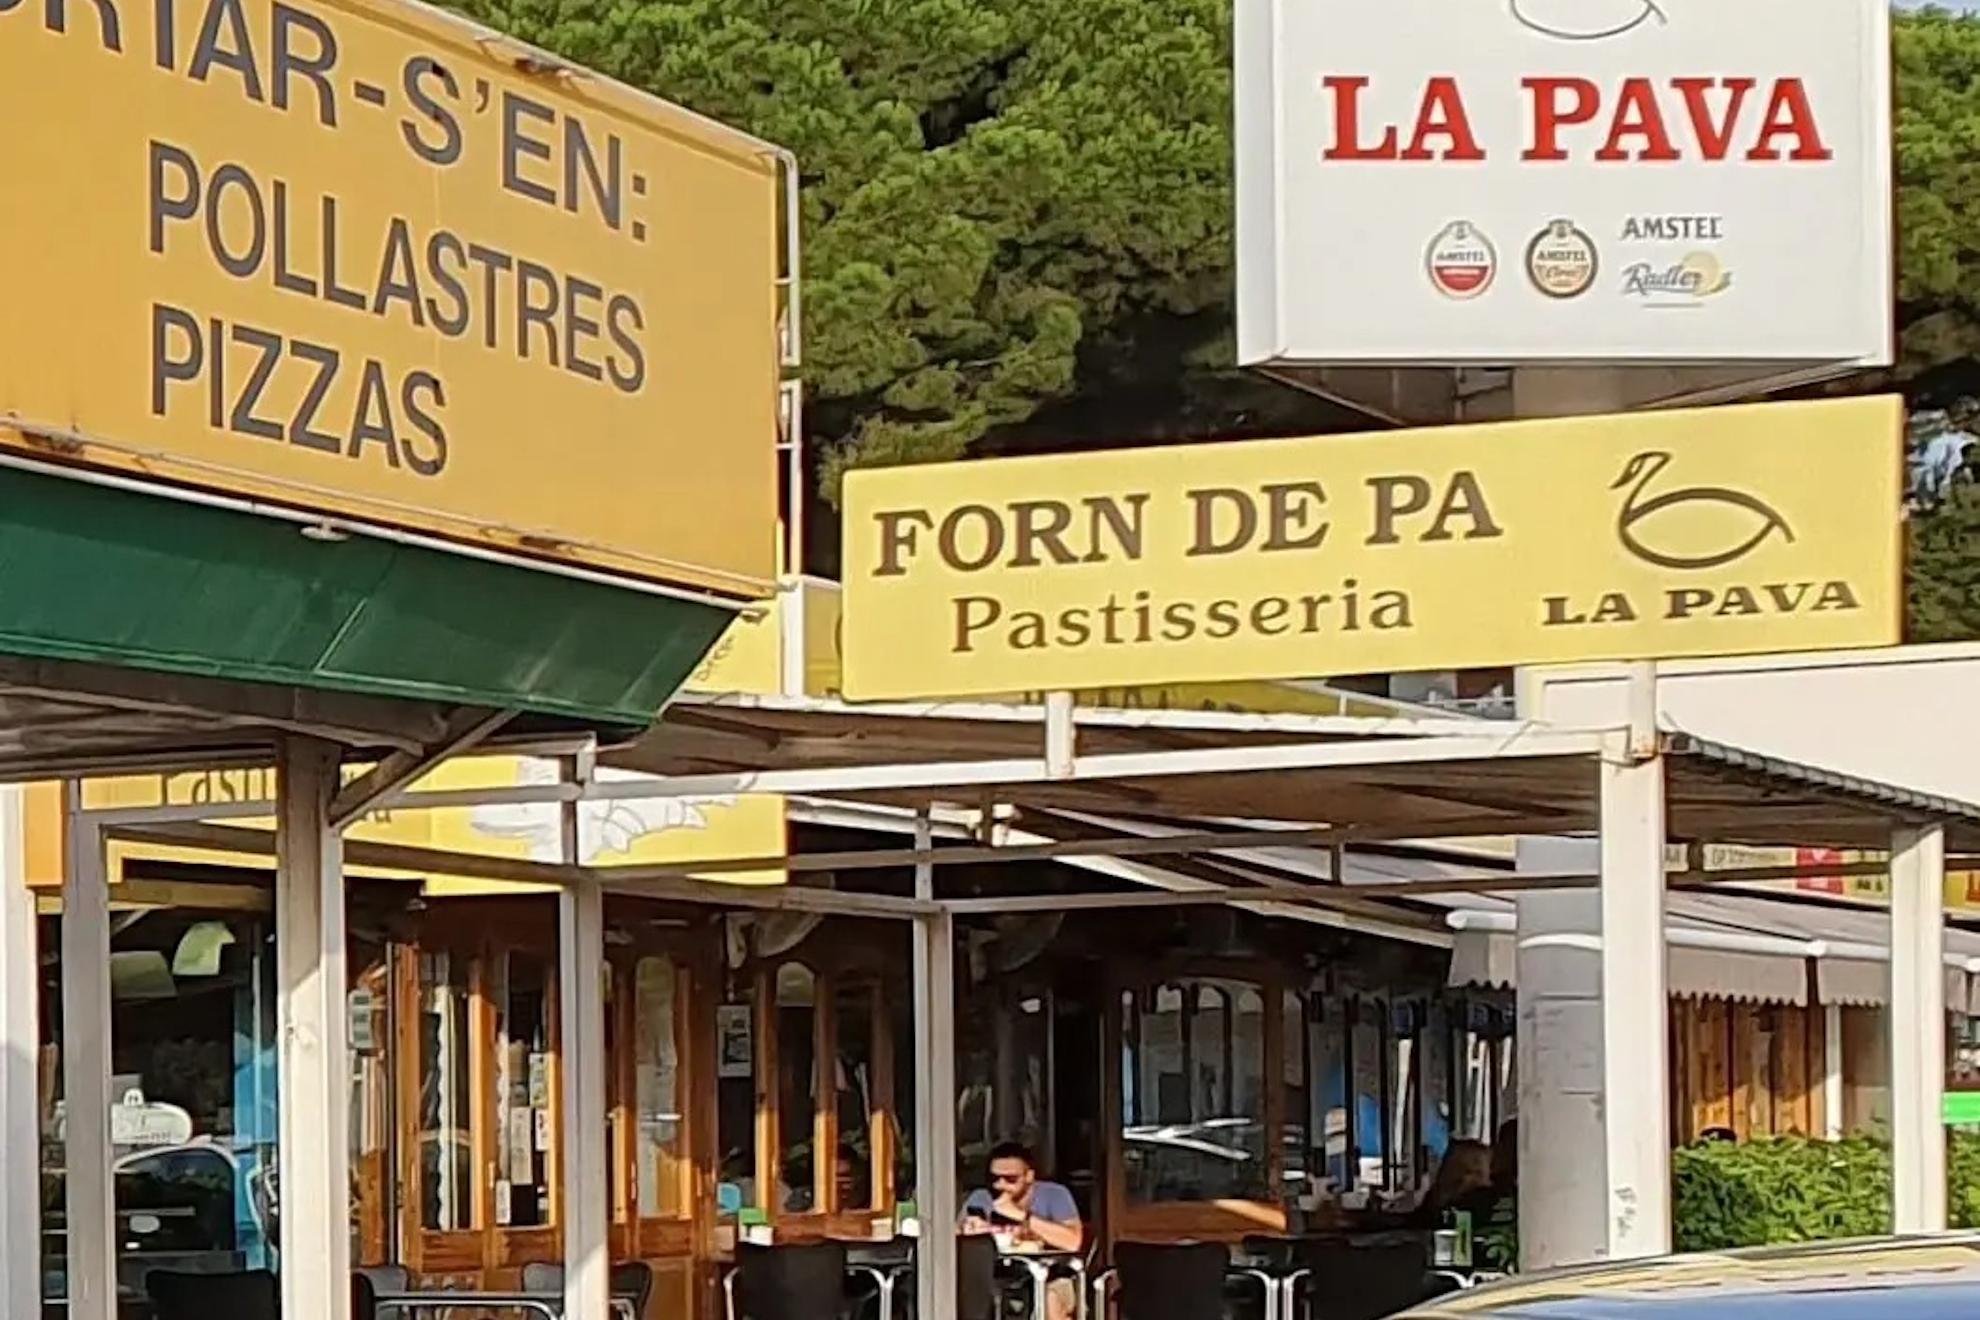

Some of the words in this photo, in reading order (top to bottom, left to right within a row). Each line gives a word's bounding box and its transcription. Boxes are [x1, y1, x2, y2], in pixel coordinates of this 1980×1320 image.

[0, 0, 646, 241] TAR-S'EN:
[1322, 76, 1486, 161] LA
[1521, 76, 1833, 161] PAVA
[149, 140, 645, 393] POLLASTRES
[1620, 216, 1723, 239] AMSTEL
[1621, 262, 1703, 296] Radler
[152, 303, 448, 476] PIZZAS
[872, 493, 1150, 577] FORN
[1185, 480, 1329, 557] DE
[1365, 470, 1504, 546] PA
[951, 578, 1413, 653] Pastisseria
[1542, 593, 1637, 625] LA
[1663, 580, 1861, 619] PAVA
